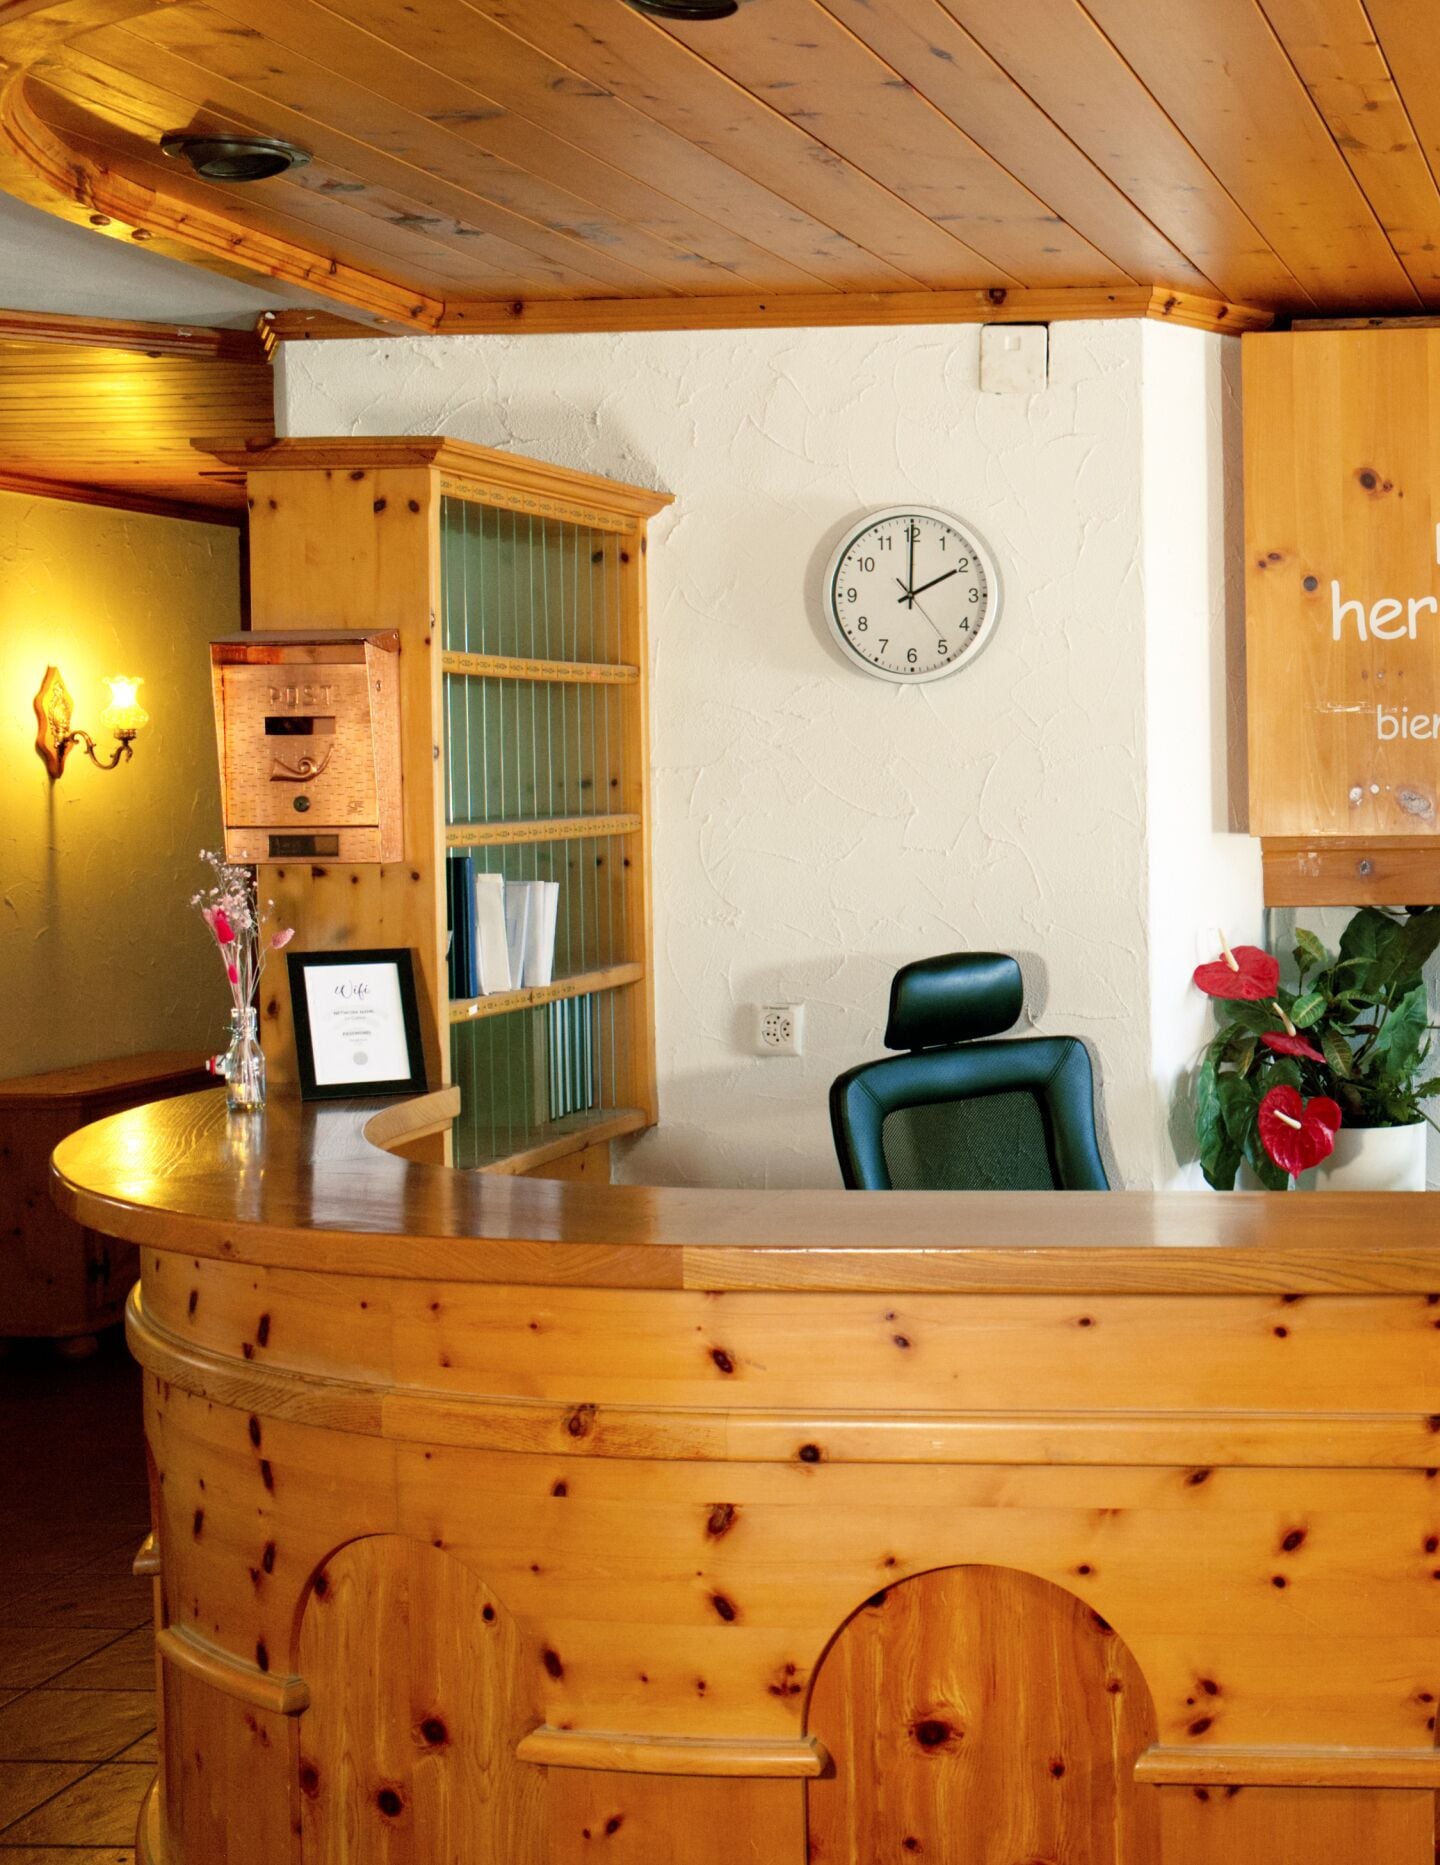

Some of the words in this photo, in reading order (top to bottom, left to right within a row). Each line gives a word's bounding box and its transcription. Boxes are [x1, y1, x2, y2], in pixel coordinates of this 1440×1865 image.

[904, 527, 921, 543] 12
[877, 536, 892, 550] 11
[939, 536, 946, 551] 1
[857, 557, 875, 572] 10
[958, 558, 969, 573] 2
[847, 588, 857, 603] 9
[968, 588, 979, 603] 3
[857, 616, 868, 631] 8
[959, 617, 970, 631] 4
[878, 639, 889, 654] 7
[937, 639, 948, 654] 5
[907, 648, 918, 663] 6
[268, 685, 331, 706] POST
[334, 980, 371, 1000] Wifi
